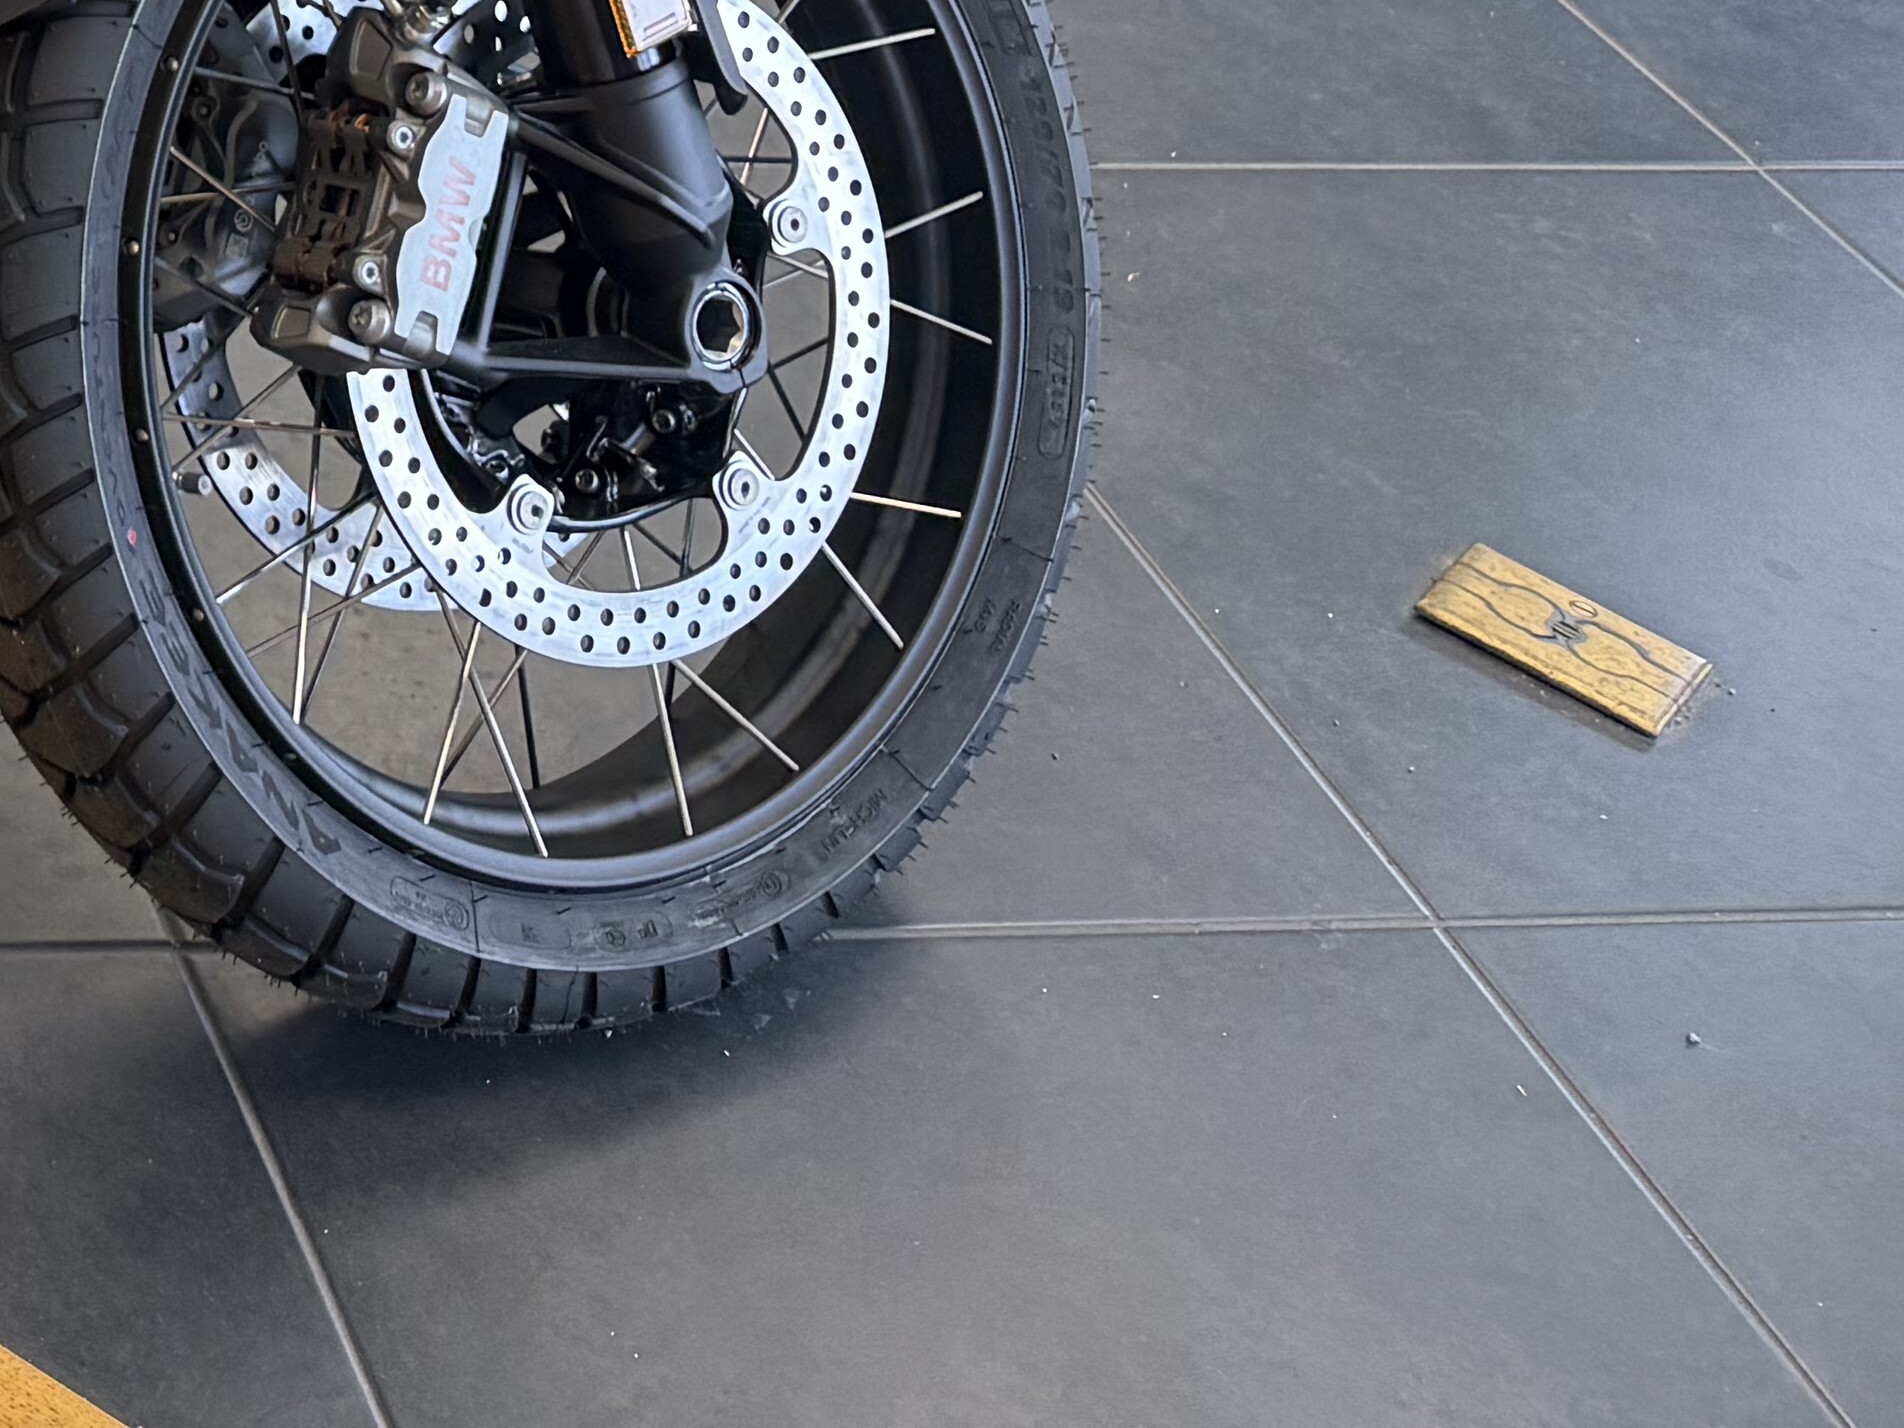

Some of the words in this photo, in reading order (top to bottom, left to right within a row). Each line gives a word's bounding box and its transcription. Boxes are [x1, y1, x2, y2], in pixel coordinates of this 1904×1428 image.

[419, 155, 477, 293] BMW
[138, 570, 343, 855] ANAKEE
[820, 787, 890, 862] MICHELIN
